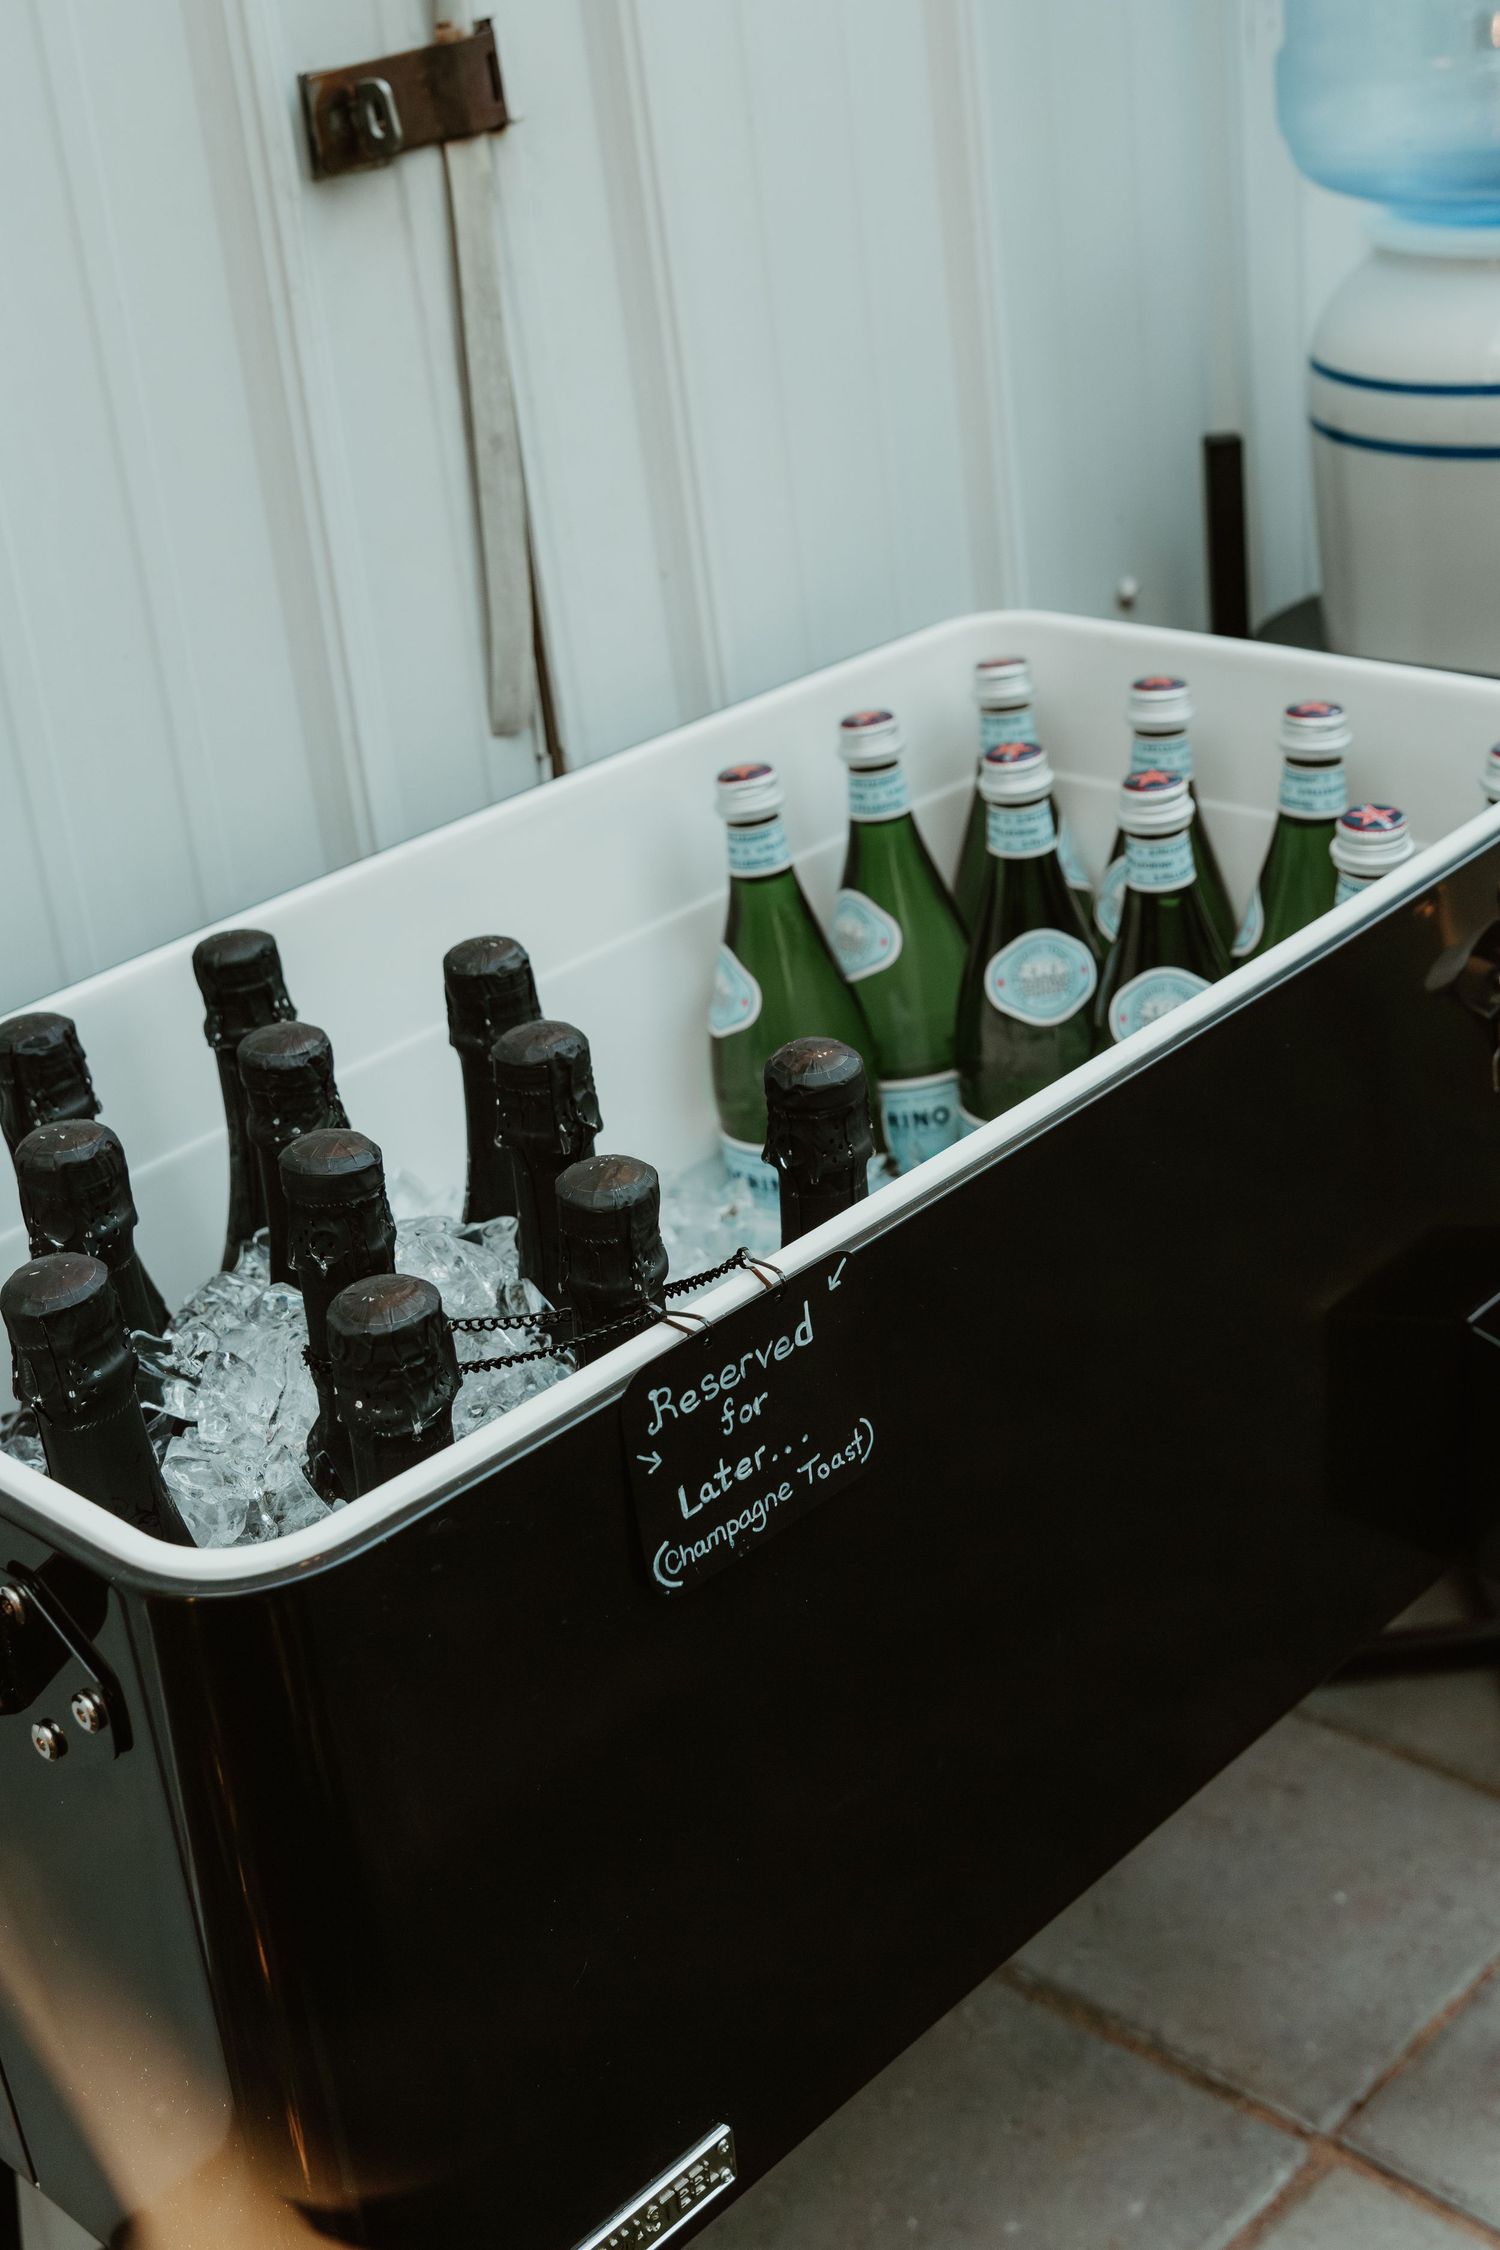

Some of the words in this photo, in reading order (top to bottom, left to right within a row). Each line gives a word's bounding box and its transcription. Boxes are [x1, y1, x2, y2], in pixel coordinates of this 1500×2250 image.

[648, 1300, 815, 1436] Reserved
[720, 1391, 769, 1436] for
[653, 1481, 794, 1588] (Champagne
[796, 1417, 875, 1485] Toast)
